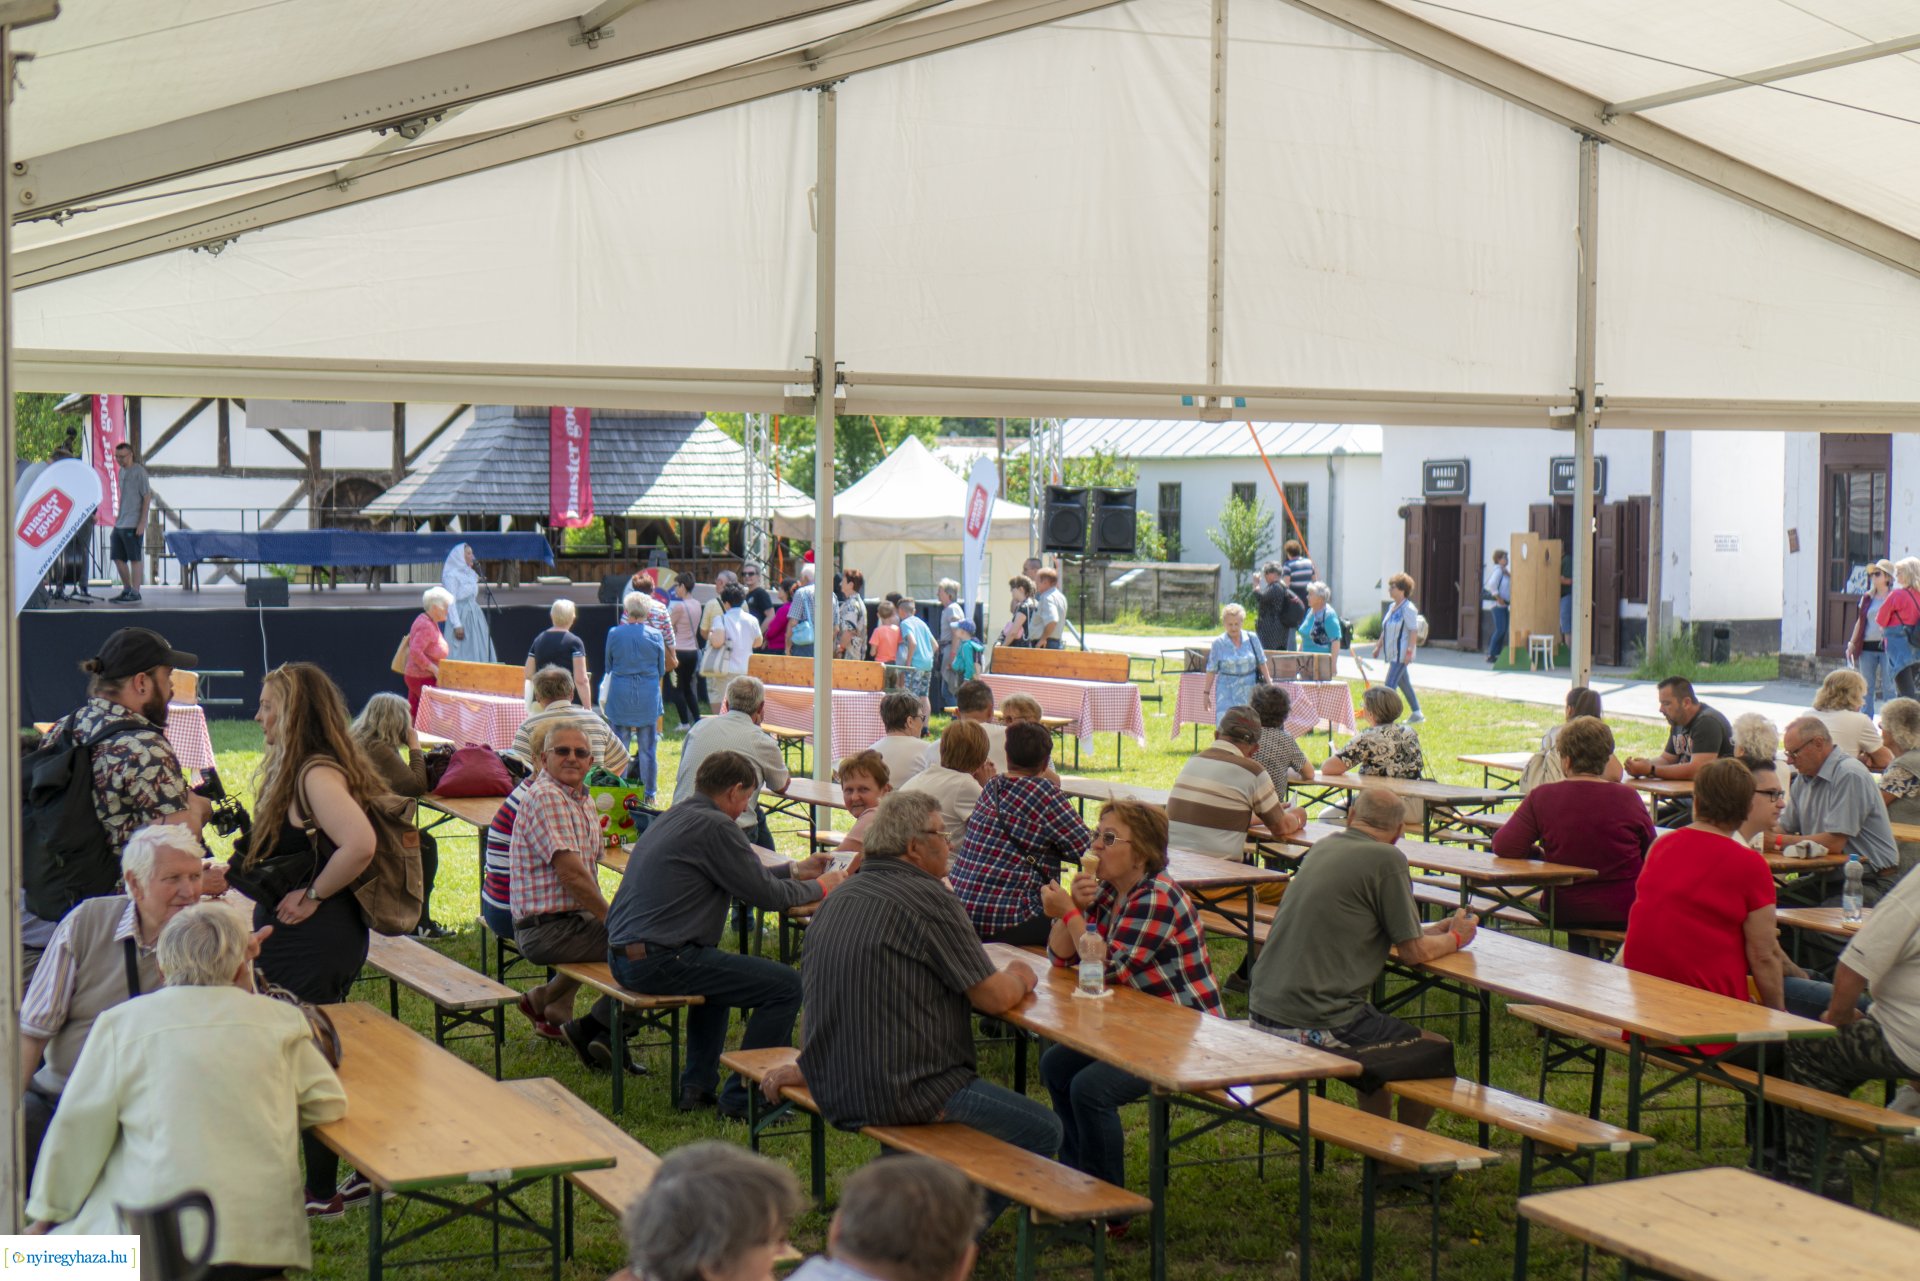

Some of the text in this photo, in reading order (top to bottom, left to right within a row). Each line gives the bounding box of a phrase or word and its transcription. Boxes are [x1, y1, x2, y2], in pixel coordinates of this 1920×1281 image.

[100, 394, 113, 432] goo
[566, 440, 580, 518] master
[22, 493, 60, 537] master
[35, 505, 64, 538] good
